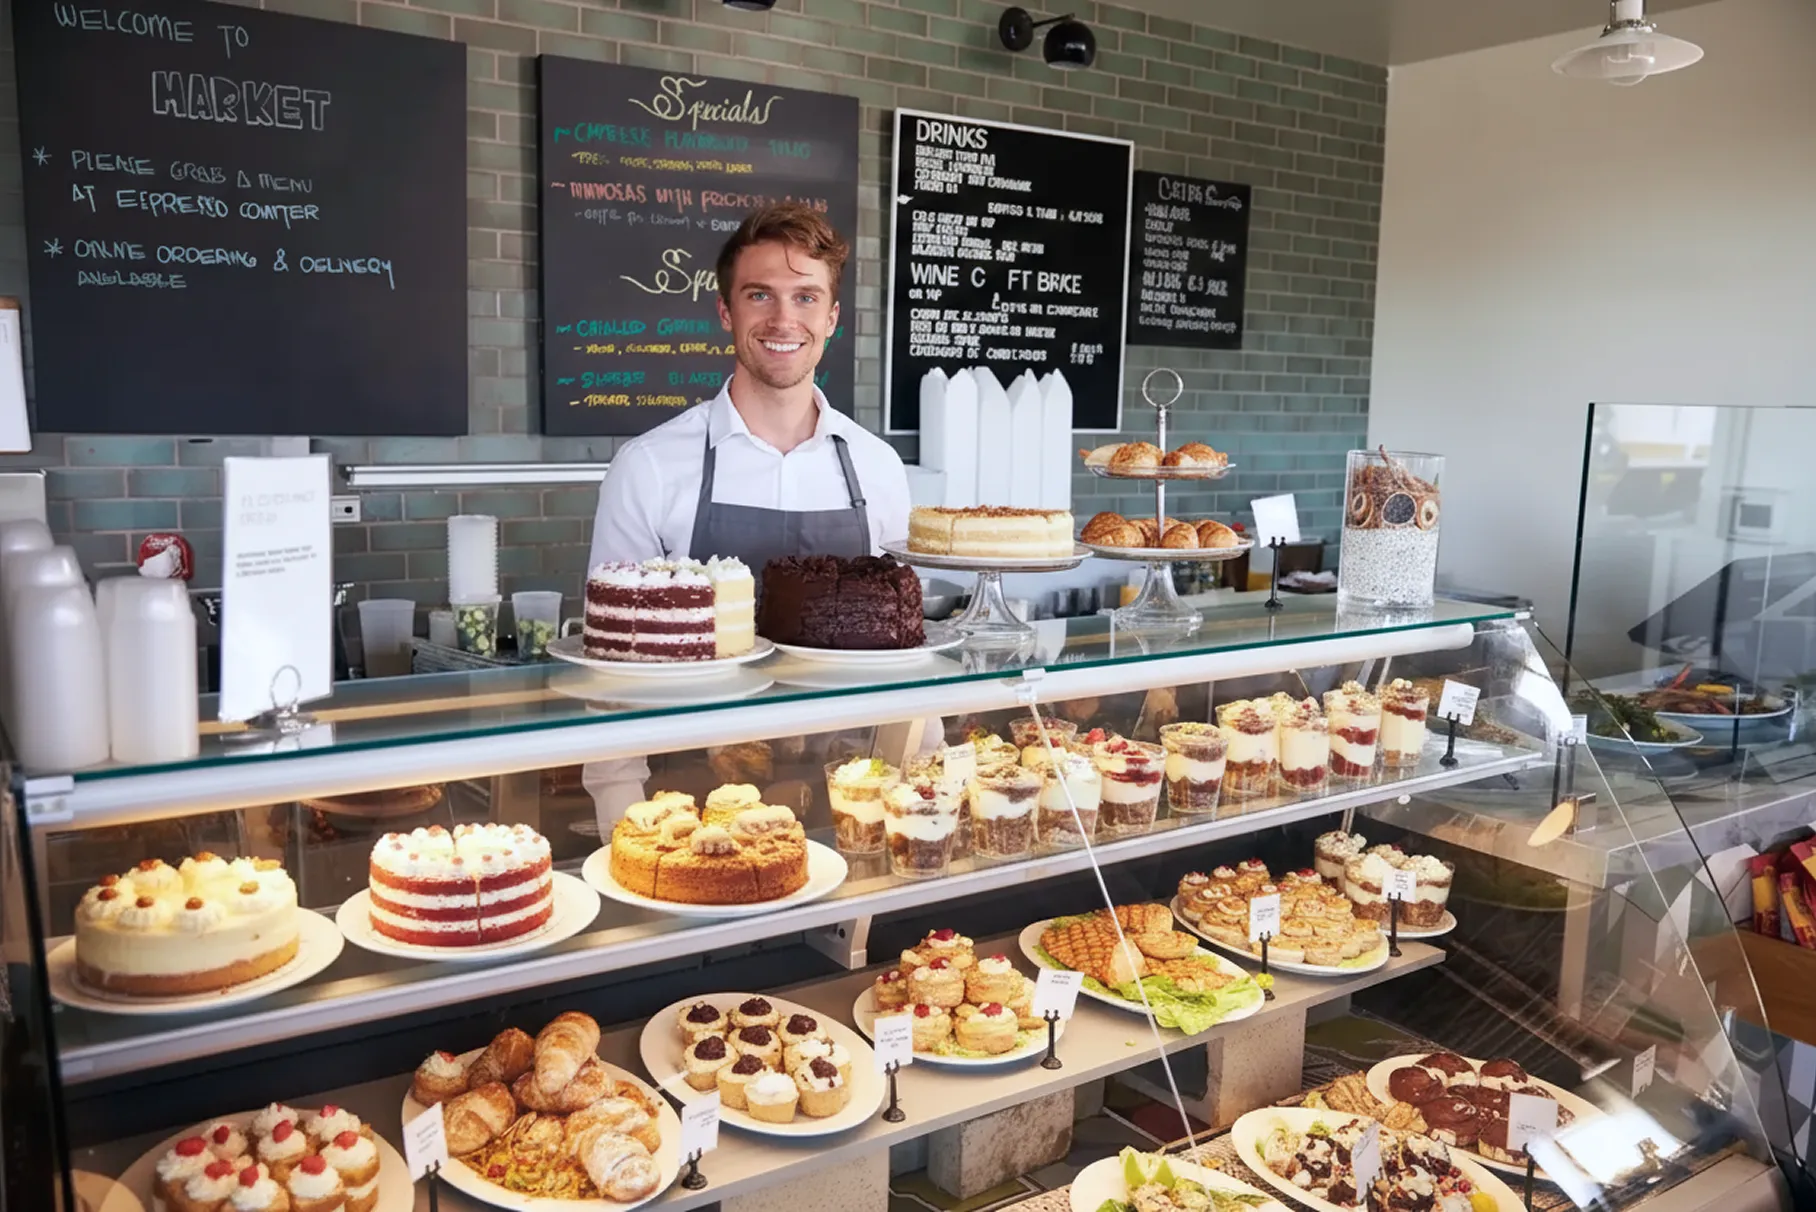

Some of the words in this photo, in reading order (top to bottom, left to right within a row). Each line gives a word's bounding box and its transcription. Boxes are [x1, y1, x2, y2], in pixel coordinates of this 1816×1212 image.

[54, 2, 194, 42] WELCOME
[217, 25, 249, 59] TO
[151, 70, 331, 131] MARKET
[915, 118, 989, 150] DRINKS
[237, 169, 252, 189] A
[258, 173, 313, 194] MENU
[72, 183, 96, 213] AT
[273, 247, 289, 272] &
[910, 262, 960, 287] WINE
